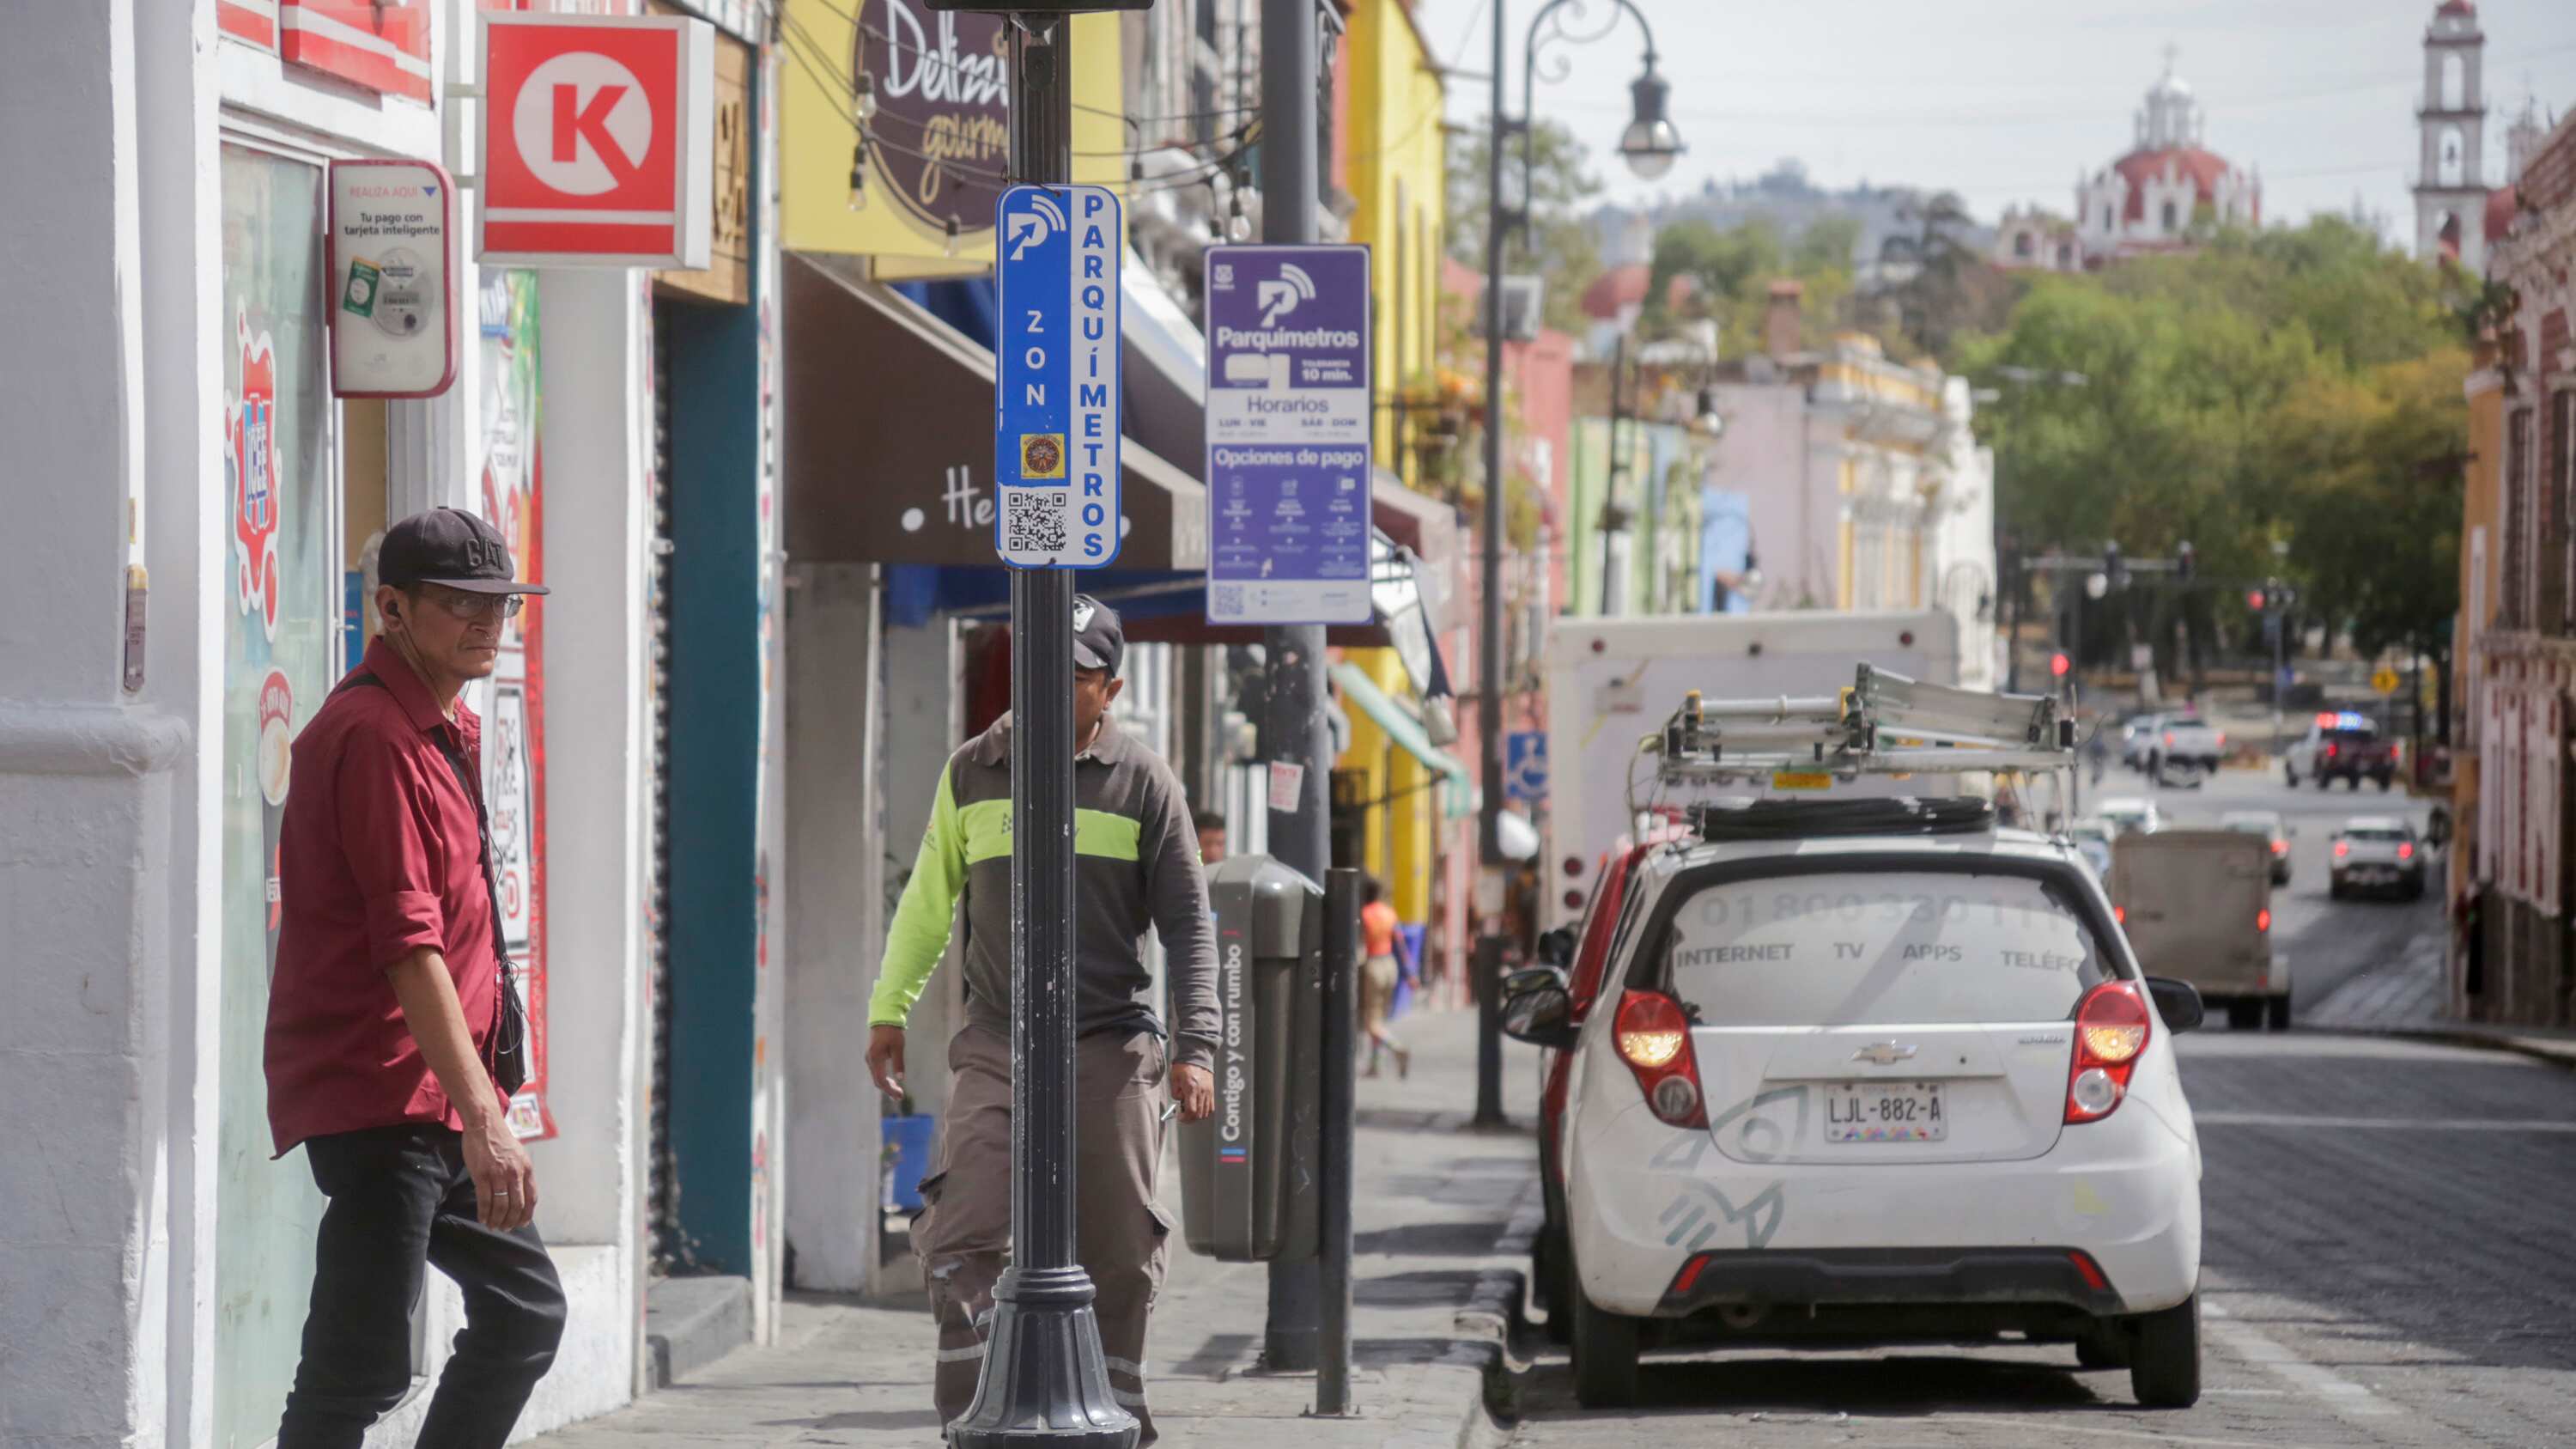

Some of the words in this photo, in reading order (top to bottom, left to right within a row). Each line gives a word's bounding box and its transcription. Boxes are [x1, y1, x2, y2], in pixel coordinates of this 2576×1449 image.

[551, 83, 642, 187] K
[349, 186, 390, 198] REALIZA
[344, 225, 380, 237] tarjeta
[383, 224, 440, 237] inteligente
[361, 212, 372, 222] Tu
[375, 215, 402, 225] pago
[1079, 194, 1107, 557] PARQUÍMETROS
[1302, 369, 1320, 381] 10
[1322, 369, 1353, 381] min.
[1248, 395, 1330, 413] Horarios
[1331, 418, 1358, 427] DOM
[1215, 447, 1293, 469] Opciones
[1297, 449, 1320, 466] de
[1321, 451, 1364, 470] pago
[941, 465, 997, 529] He
[466, 537, 504, 571] CAT
[1676, 943, 1795, 969] INTERNET
[1833, 942, 1866, 959] TV
[1903, 943, 1964, 962] APPS
[2001, 947, 2081, 974] TELÉFO
[1224, 944, 1242, 1008] rumbo
[1227, 1014, 1241, 1047] con
[1227, 1050, 1244, 1063] y
[1221, 1066, 1244, 1142] Contigo
[1829, 1096, 1941, 1123] LJL-882-A
